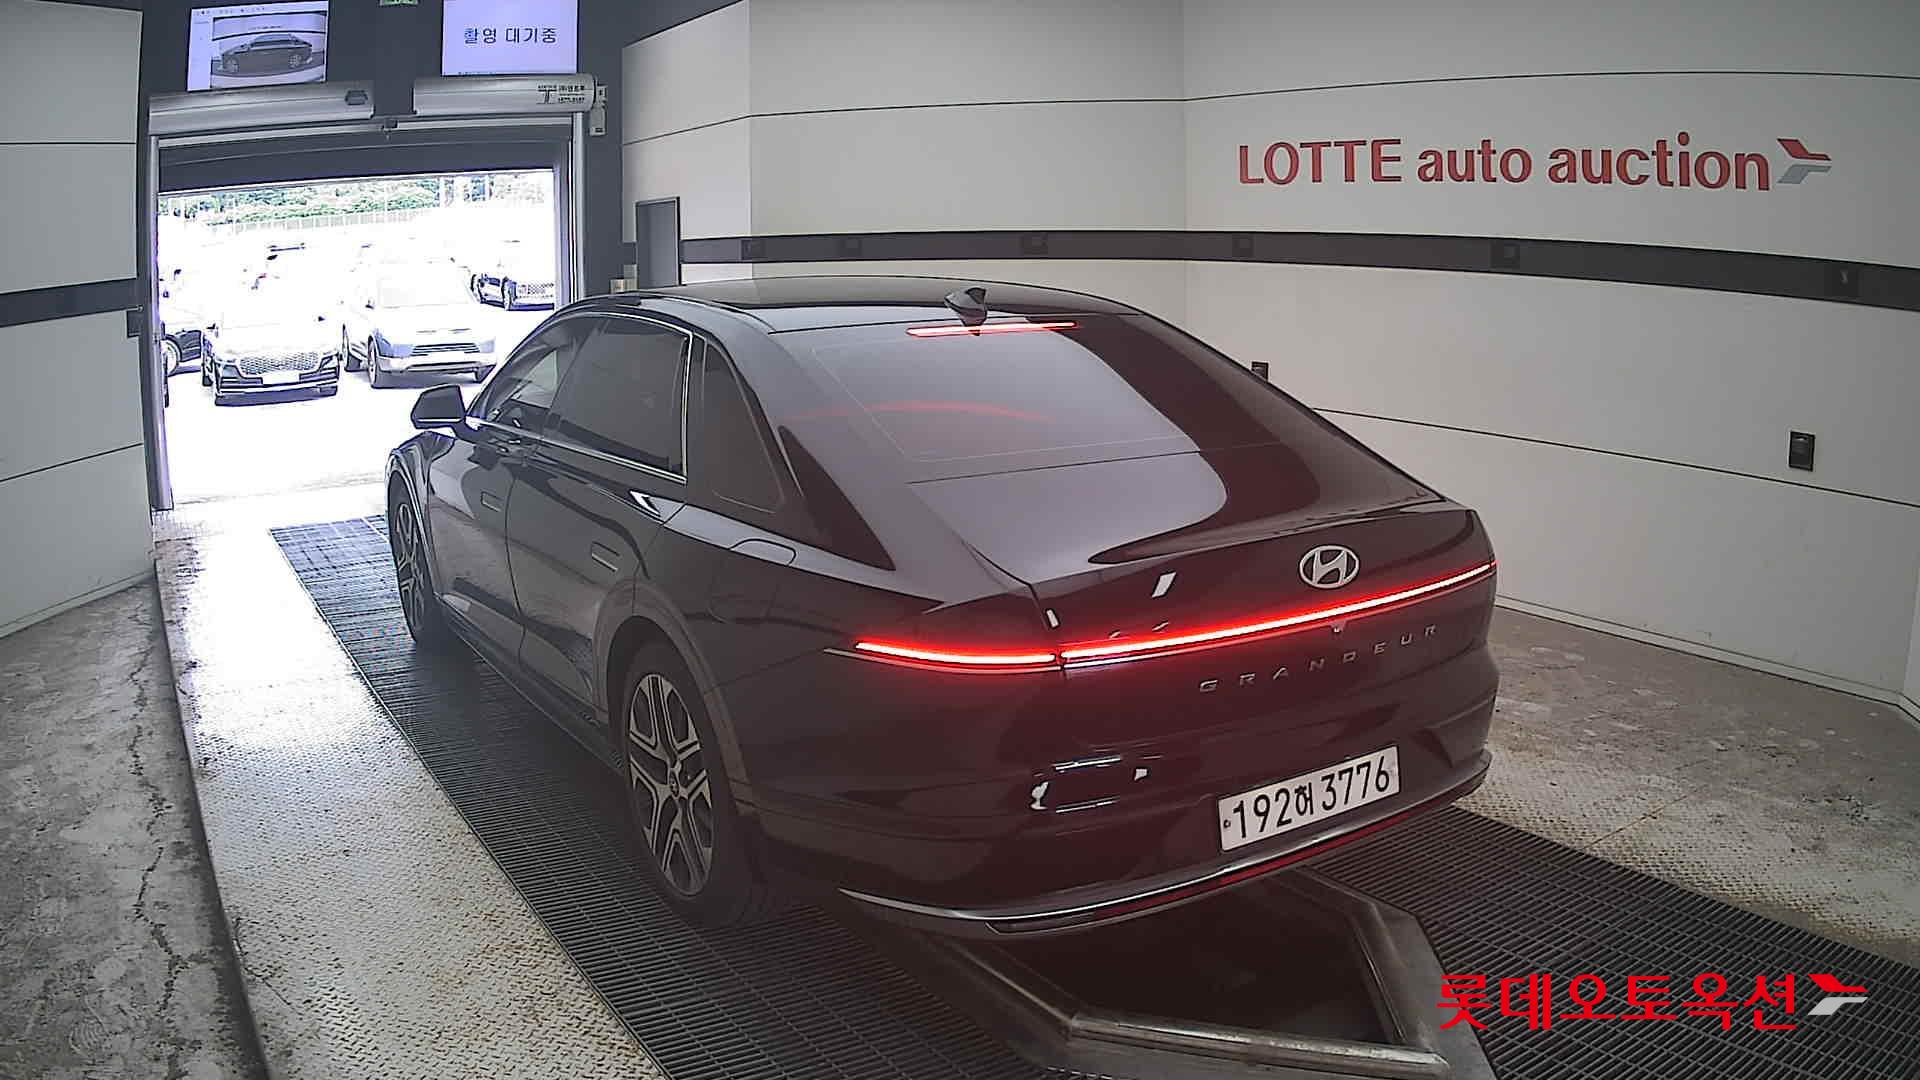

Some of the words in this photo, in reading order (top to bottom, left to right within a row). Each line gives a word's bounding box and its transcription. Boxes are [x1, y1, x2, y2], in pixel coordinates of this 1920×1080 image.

[464, 27, 498, 45] 촬영
[504, 27, 557, 44] 대기중
[1239, 138, 1402, 185] LOTTE
[1417, 138, 1533, 184] auto
[1547, 131, 1770, 191] auction
[1199, 623, 1437, 693] GRANDEUR
